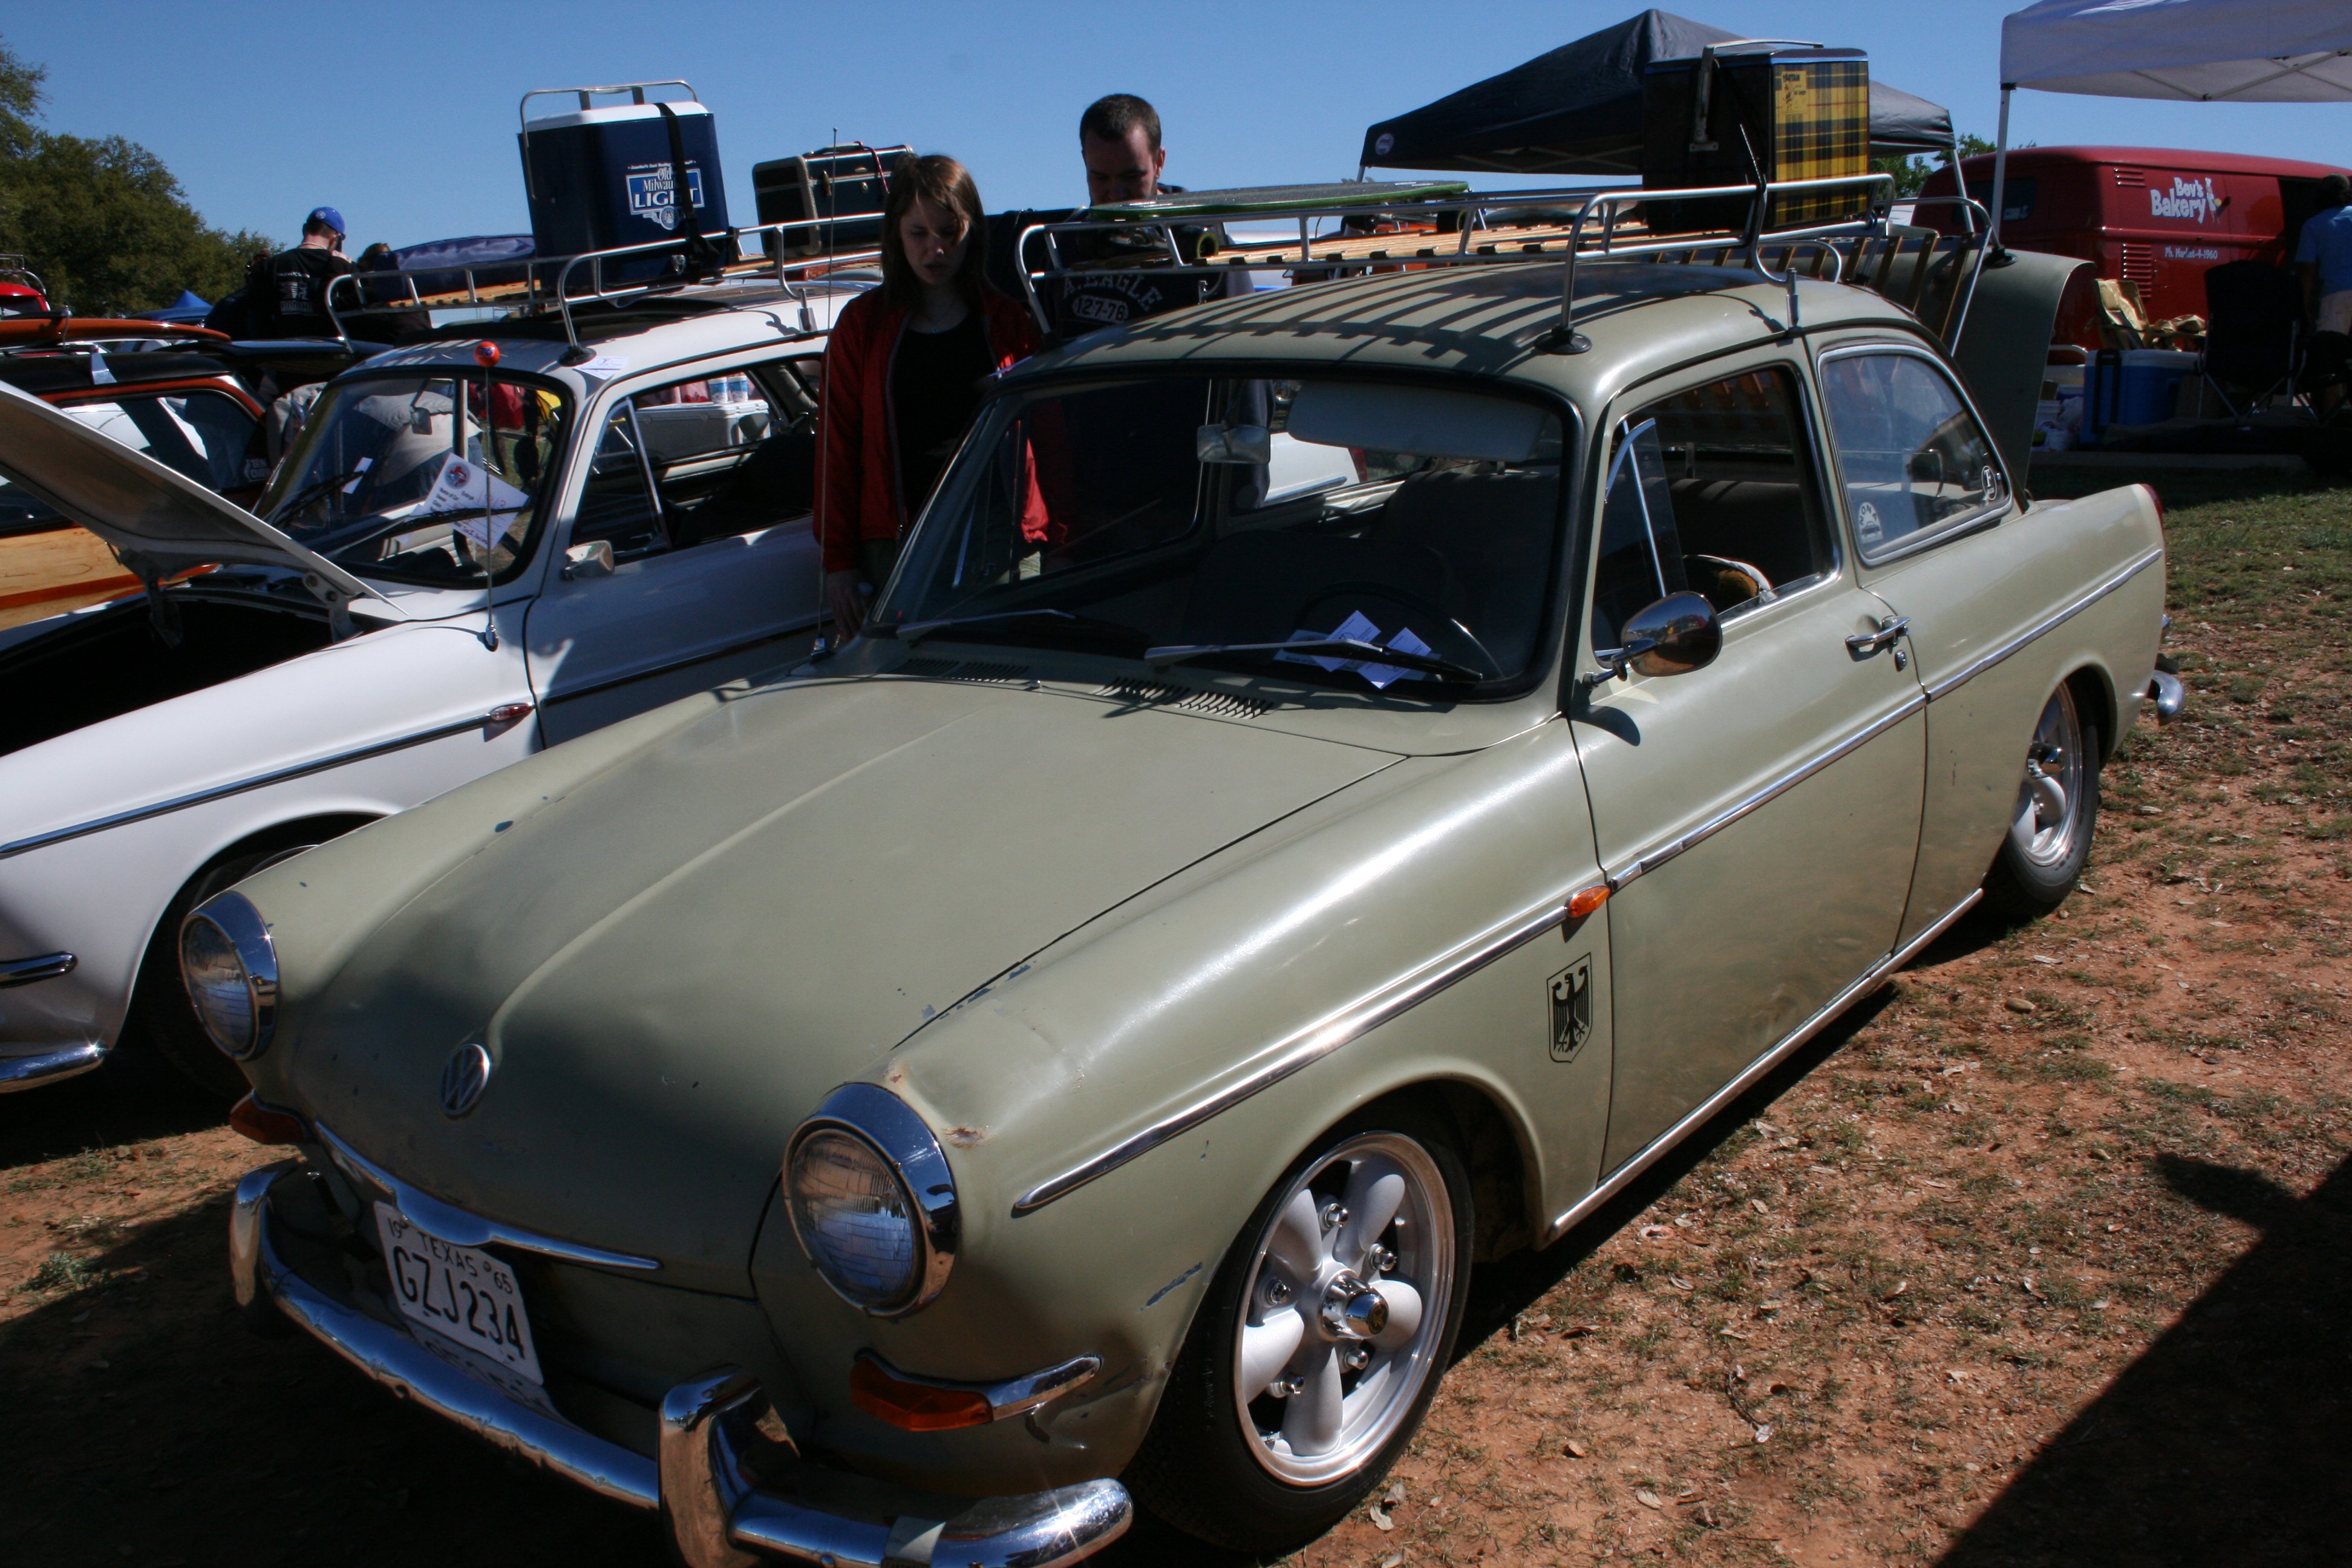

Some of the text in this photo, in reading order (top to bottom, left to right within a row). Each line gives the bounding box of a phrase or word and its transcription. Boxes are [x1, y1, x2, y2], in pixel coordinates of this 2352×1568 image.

[658, 166, 673, 181] Old
[643, 178, 674, 192] Milwau
[2174, 177, 2204, 198] Bev's
[2150, 188, 2206, 224] Bakery
[417, 1230, 478, 1277] TEXAS
[494, 1271, 513, 1295] 65
